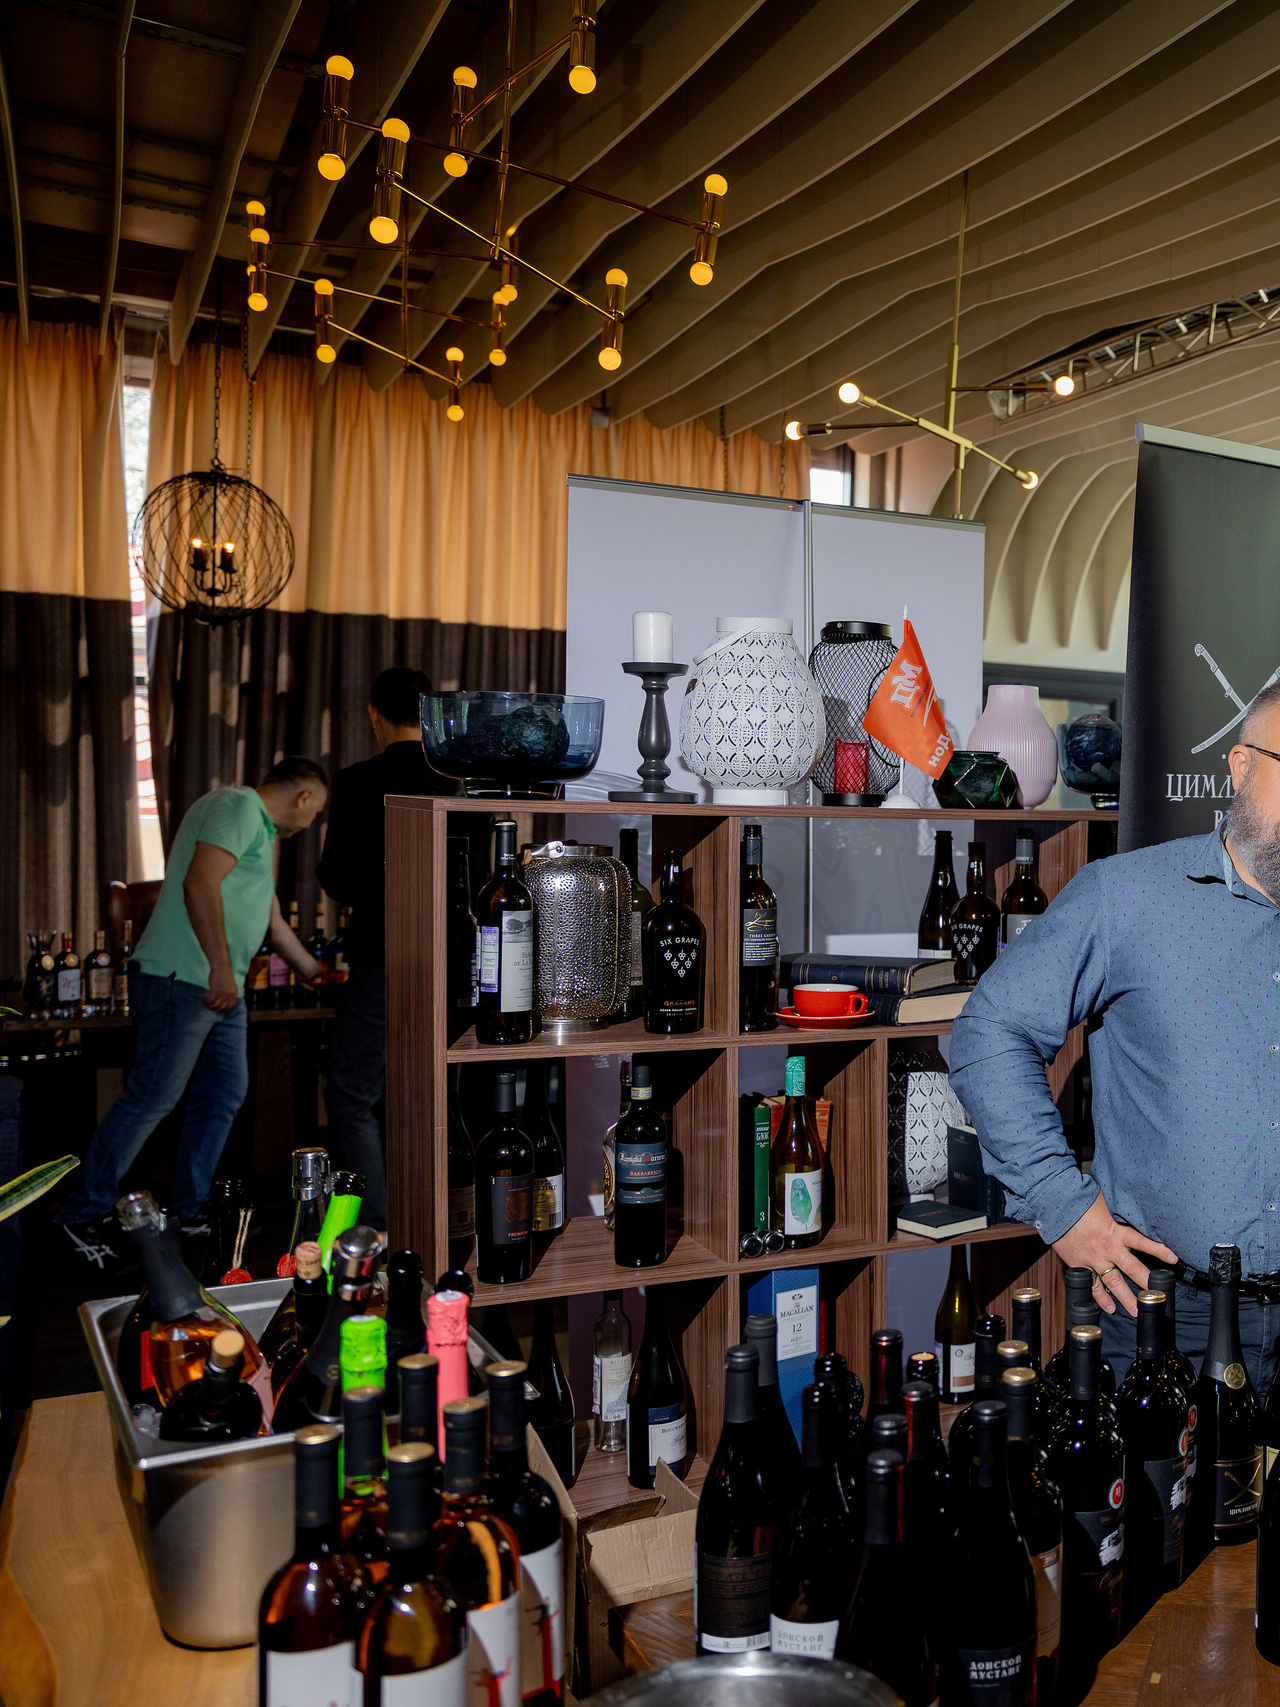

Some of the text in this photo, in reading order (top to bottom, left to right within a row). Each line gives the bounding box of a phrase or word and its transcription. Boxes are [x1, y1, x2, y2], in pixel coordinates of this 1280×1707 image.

[1165, 773, 1237, 802] ЦИМЛ
[958, 922, 984, 933] GRAPES
[660, 936, 700, 947] SIX GRAPES
[759, 1211, 766, 1221] 3
[780, 1305, 814, 1318] MACALLAN
[792, 1323, 802, 1333] 12
[778, 1630, 824, 1642] ДОНСКОЙ
[778, 1640, 824, 1652] МУСТАНГ
[968, 1664, 1021, 1680] МУСТАНГ
